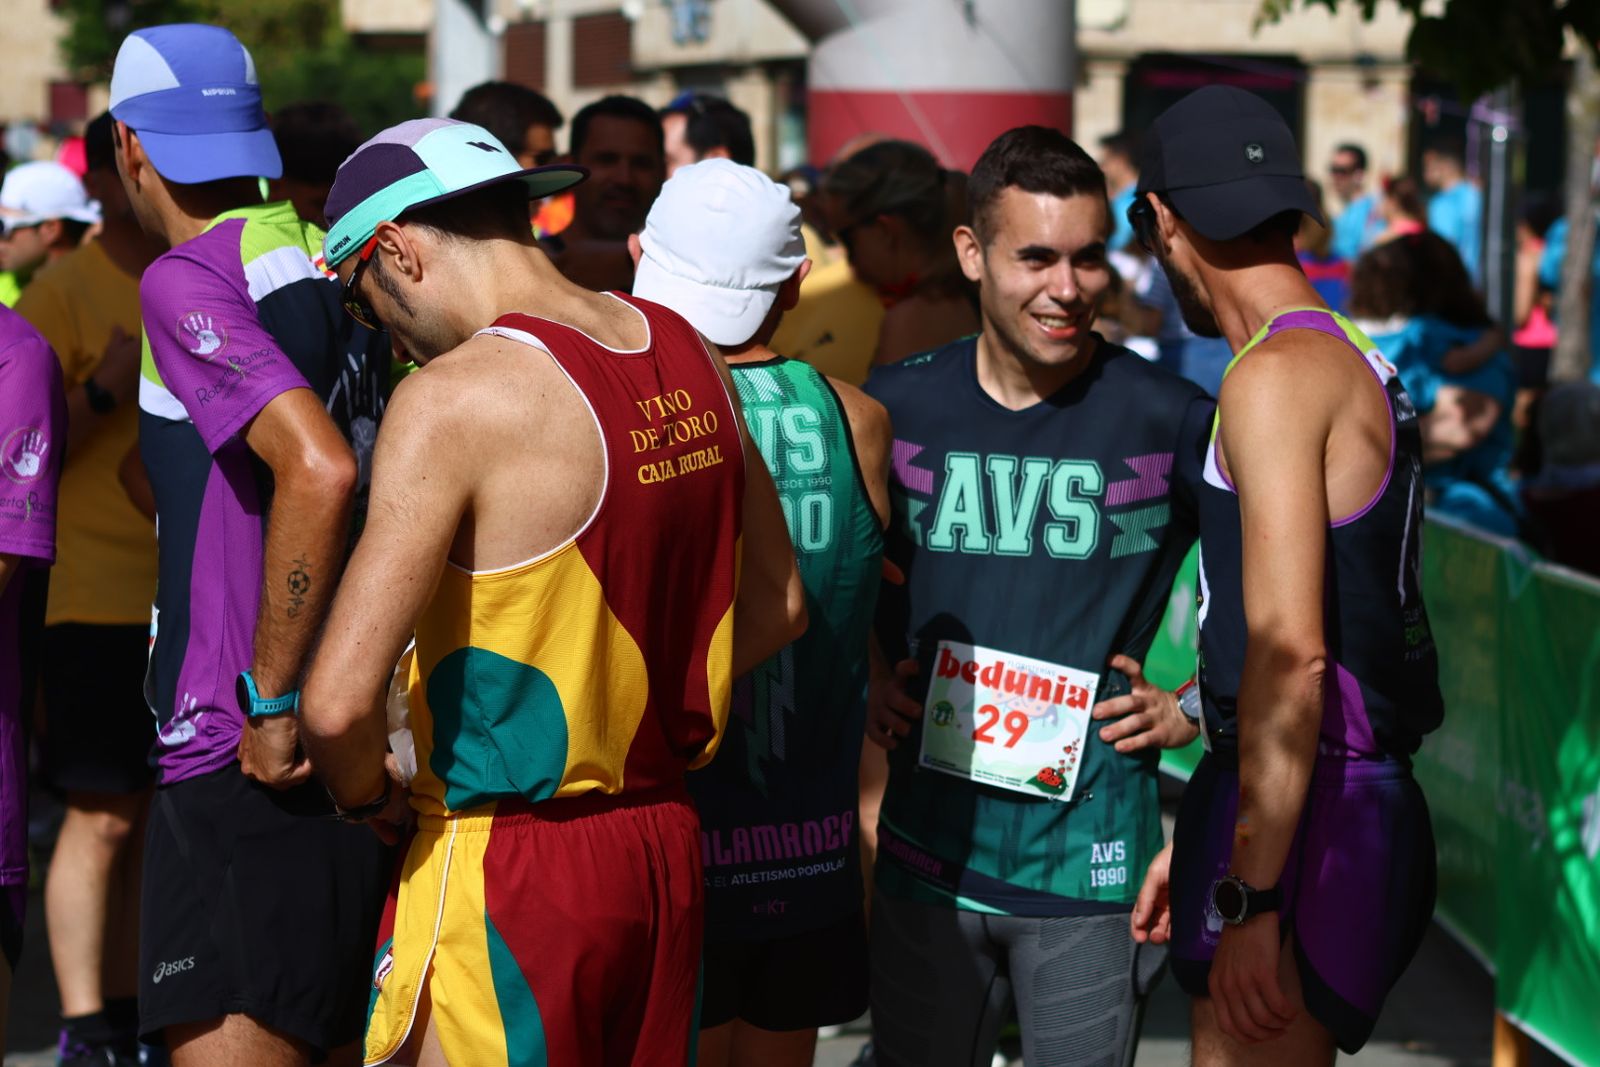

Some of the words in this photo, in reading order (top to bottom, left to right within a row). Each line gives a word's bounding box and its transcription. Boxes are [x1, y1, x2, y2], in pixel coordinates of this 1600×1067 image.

[636, 389, 692, 422] VINO
[629, 428, 661, 453] DE
[663, 410, 718, 447] TORO
[741, 404, 828, 476] VS
[637, 460, 677, 484] CAJA
[678, 445, 724, 475] RURAL
[806, 476, 832, 488] 1990
[927, 451, 1104, 560] AVS
[936, 648, 1090, 711] bedunia
[972, 704, 1029, 749] 29
[1090, 840, 1126, 864] AVS
[730, 869, 796, 886] ATLETISMO
[1090, 866, 1127, 888] 1990
